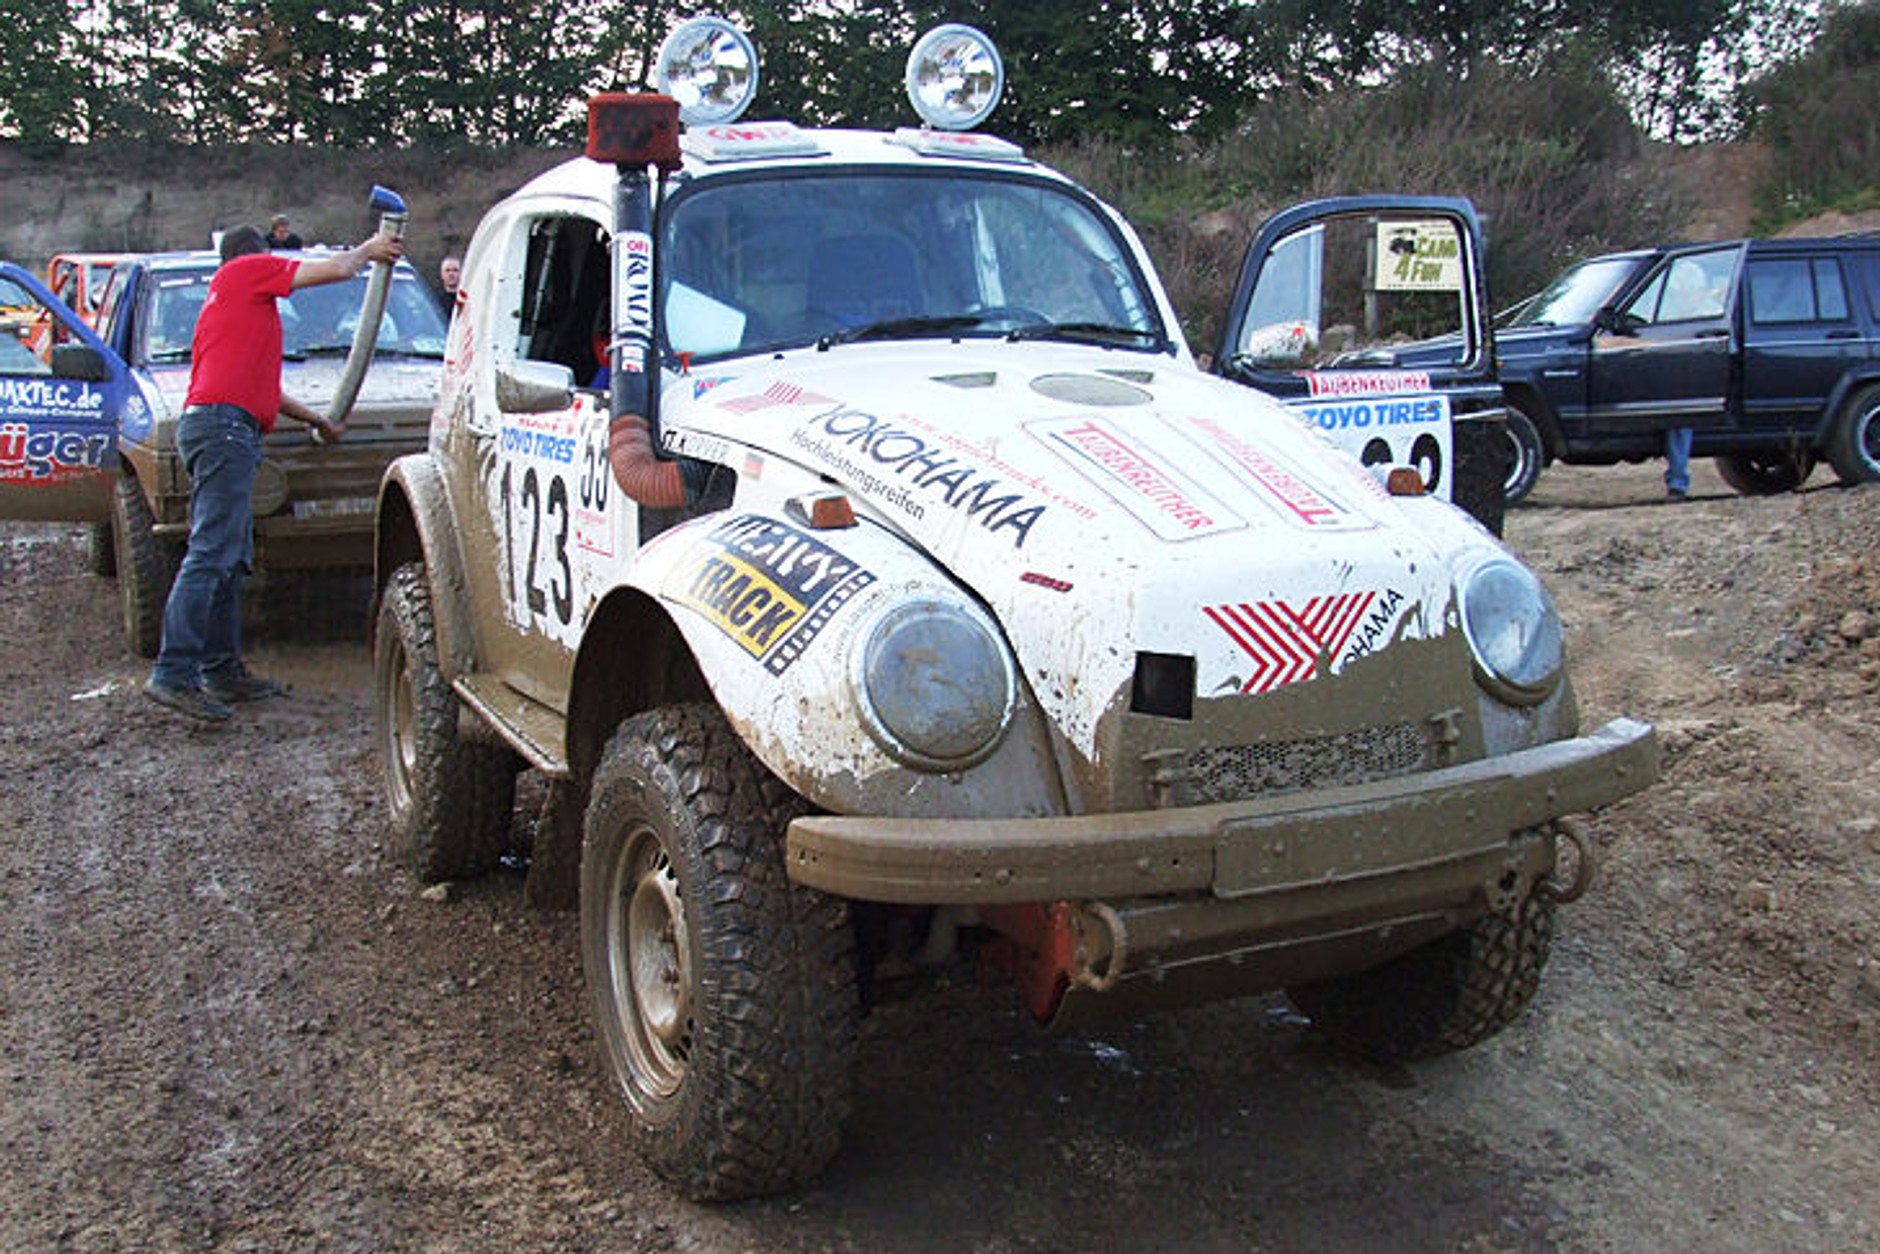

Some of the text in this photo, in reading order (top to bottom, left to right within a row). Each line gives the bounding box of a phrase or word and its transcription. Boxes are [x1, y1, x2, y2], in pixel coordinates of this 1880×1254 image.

[534, 433, 577, 464] TIRES
[1375, 400, 1442, 424] TIRES
[791, 429, 925, 521] Hochleistungsreifen
[808, 403, 1047, 548] YOKOHAMA
[501, 460, 573, 626] 123
[688, 556, 796, 648] TRACK
